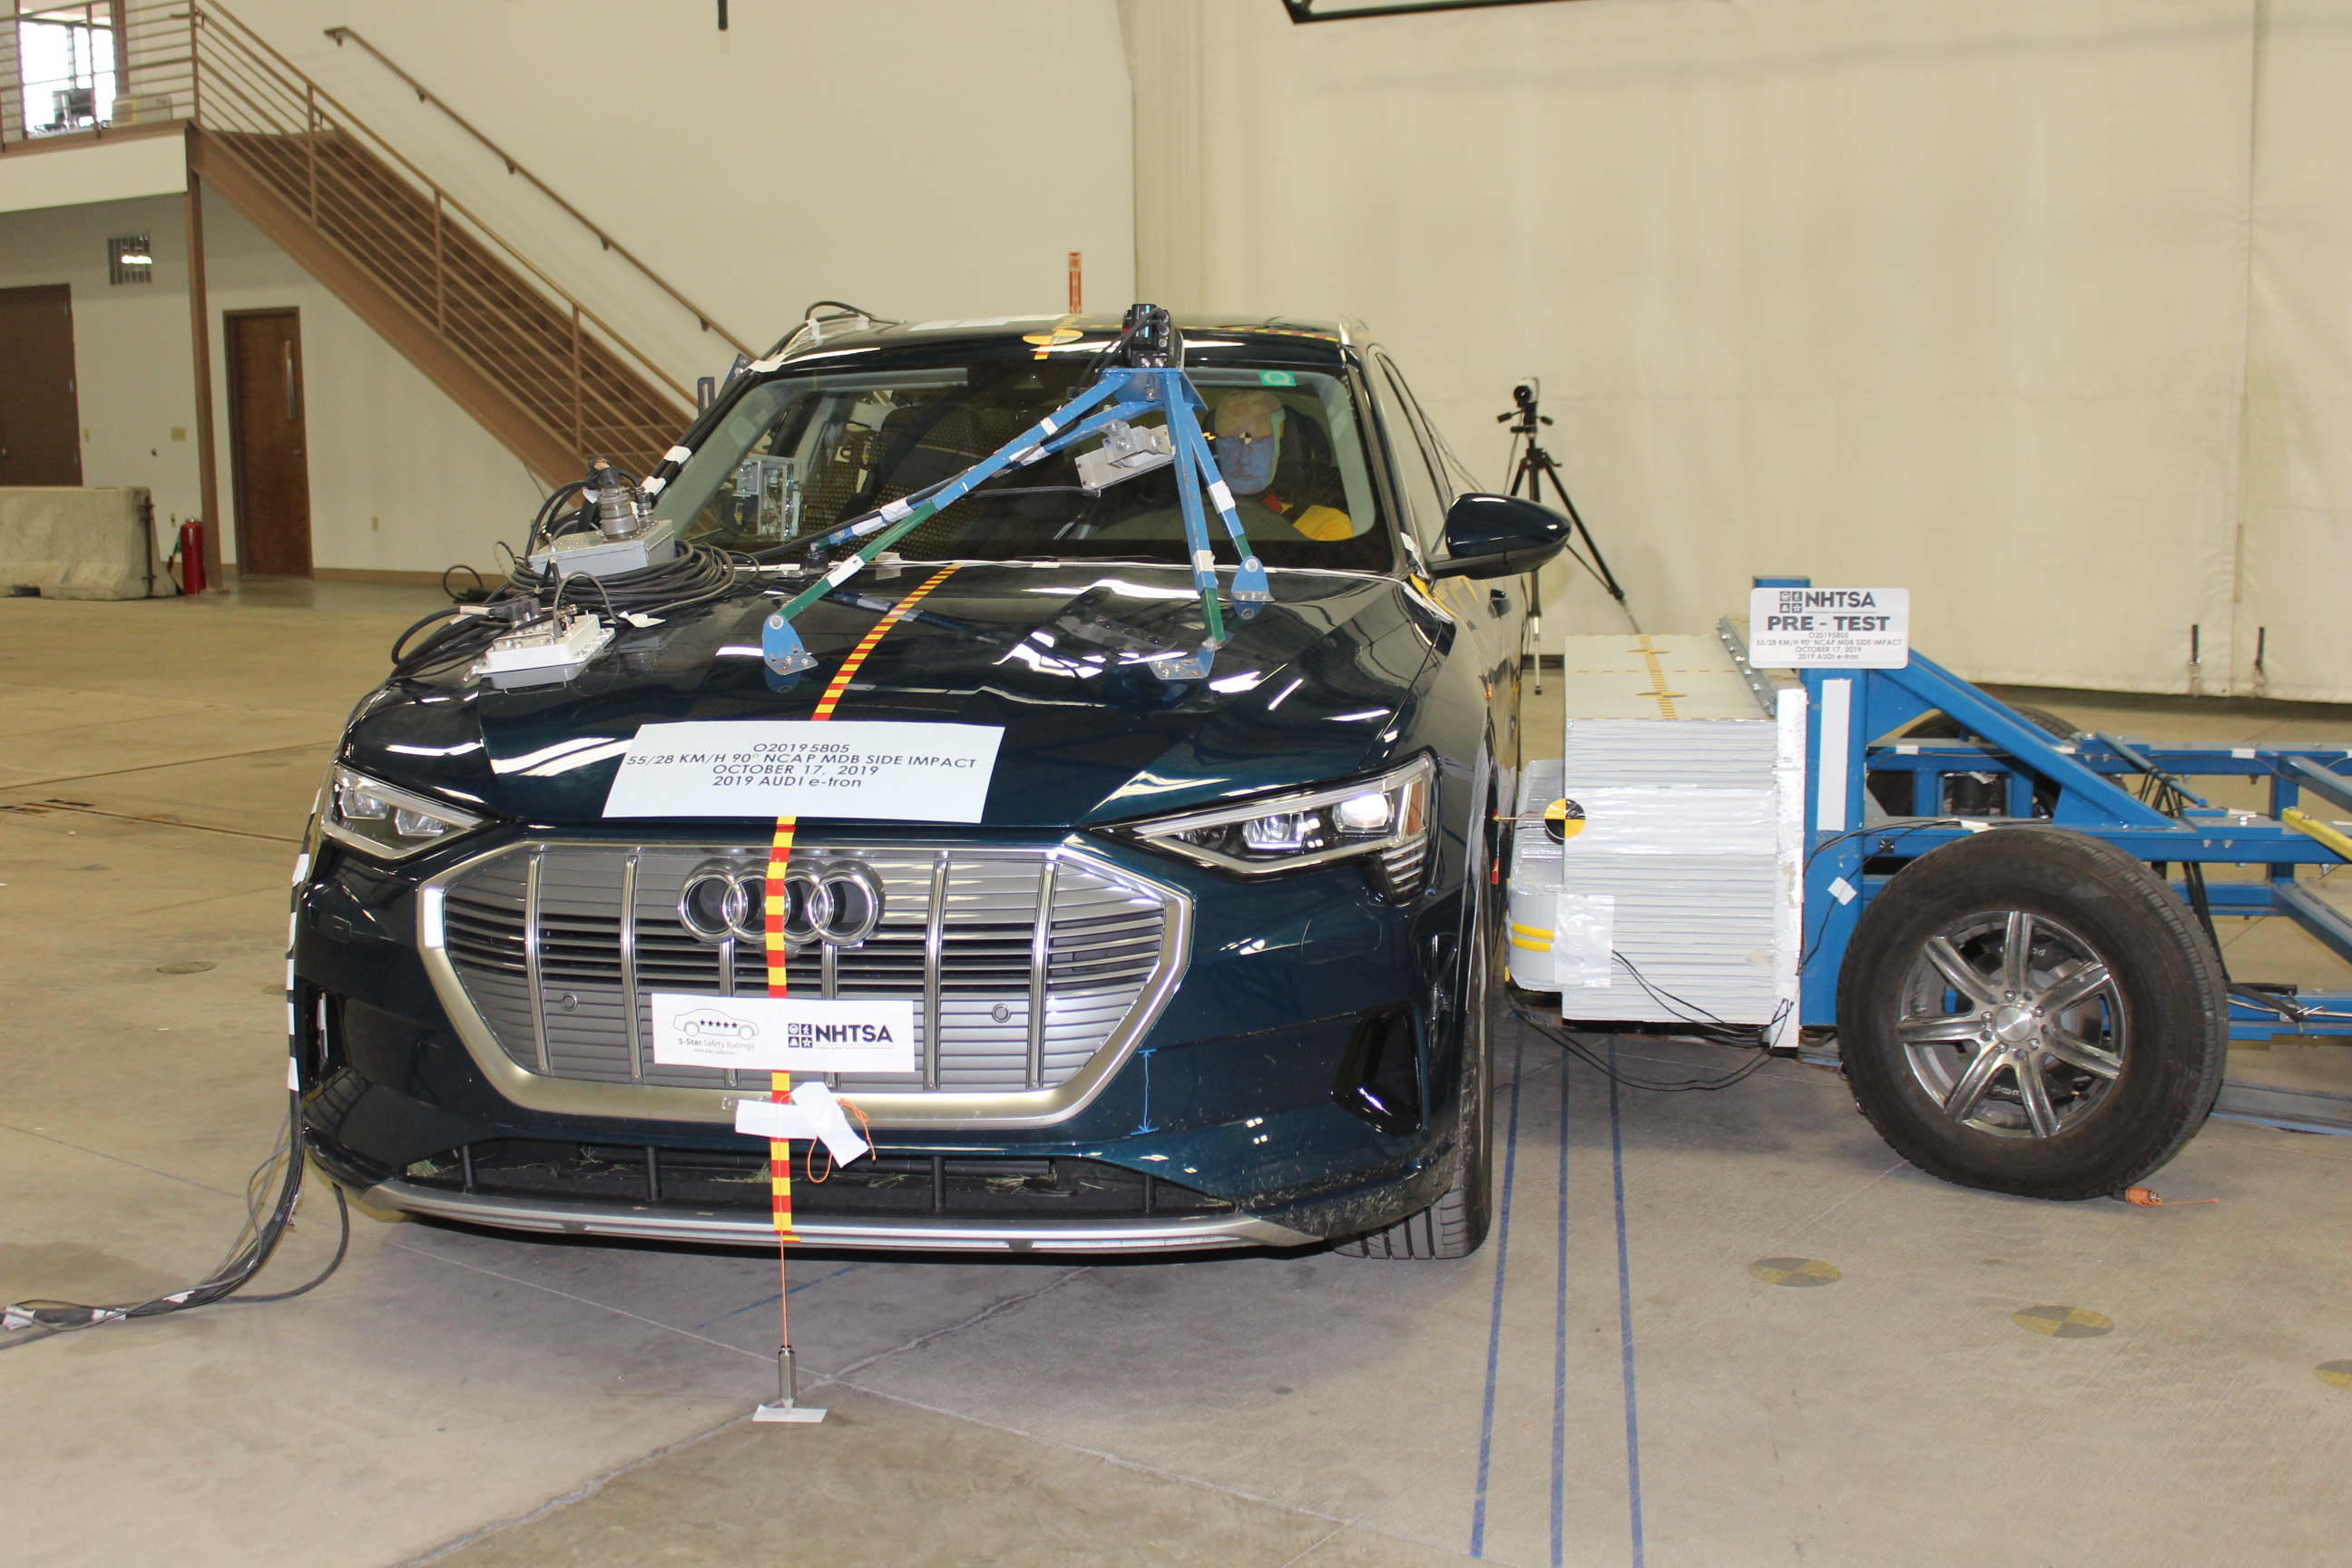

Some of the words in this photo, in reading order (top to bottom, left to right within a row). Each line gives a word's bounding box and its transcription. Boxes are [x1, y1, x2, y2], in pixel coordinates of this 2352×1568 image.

[1805, 591, 1877, 608] NHTSA
[1767, 615, 1814, 631] PRE
[1832, 615, 1891, 631] TEST
[627, 755, 674, 766] 55/28
[680, 754, 727, 764] KM/H
[764, 754, 816, 763] NCAP
[820, 754, 860, 764] MDB
[866, 755, 904, 765] SIDE
[907, 756, 977, 769] IMPACT
[712, 764, 795, 774] OCTOBER
[805, 765, 827, 776] 17,
[837, 765, 879, 776] 2019
[712, 776, 755, 786] 2019
[759, 776, 804, 786] AUDI
[808, 776, 862, 787] e-tron
[815, 1024, 894, 1043] NHTSA
[678, 1037, 702, 1046] 5-Star
[703, 1039, 725, 1050] Safety
[726, 1041, 755, 1051] Ratings
